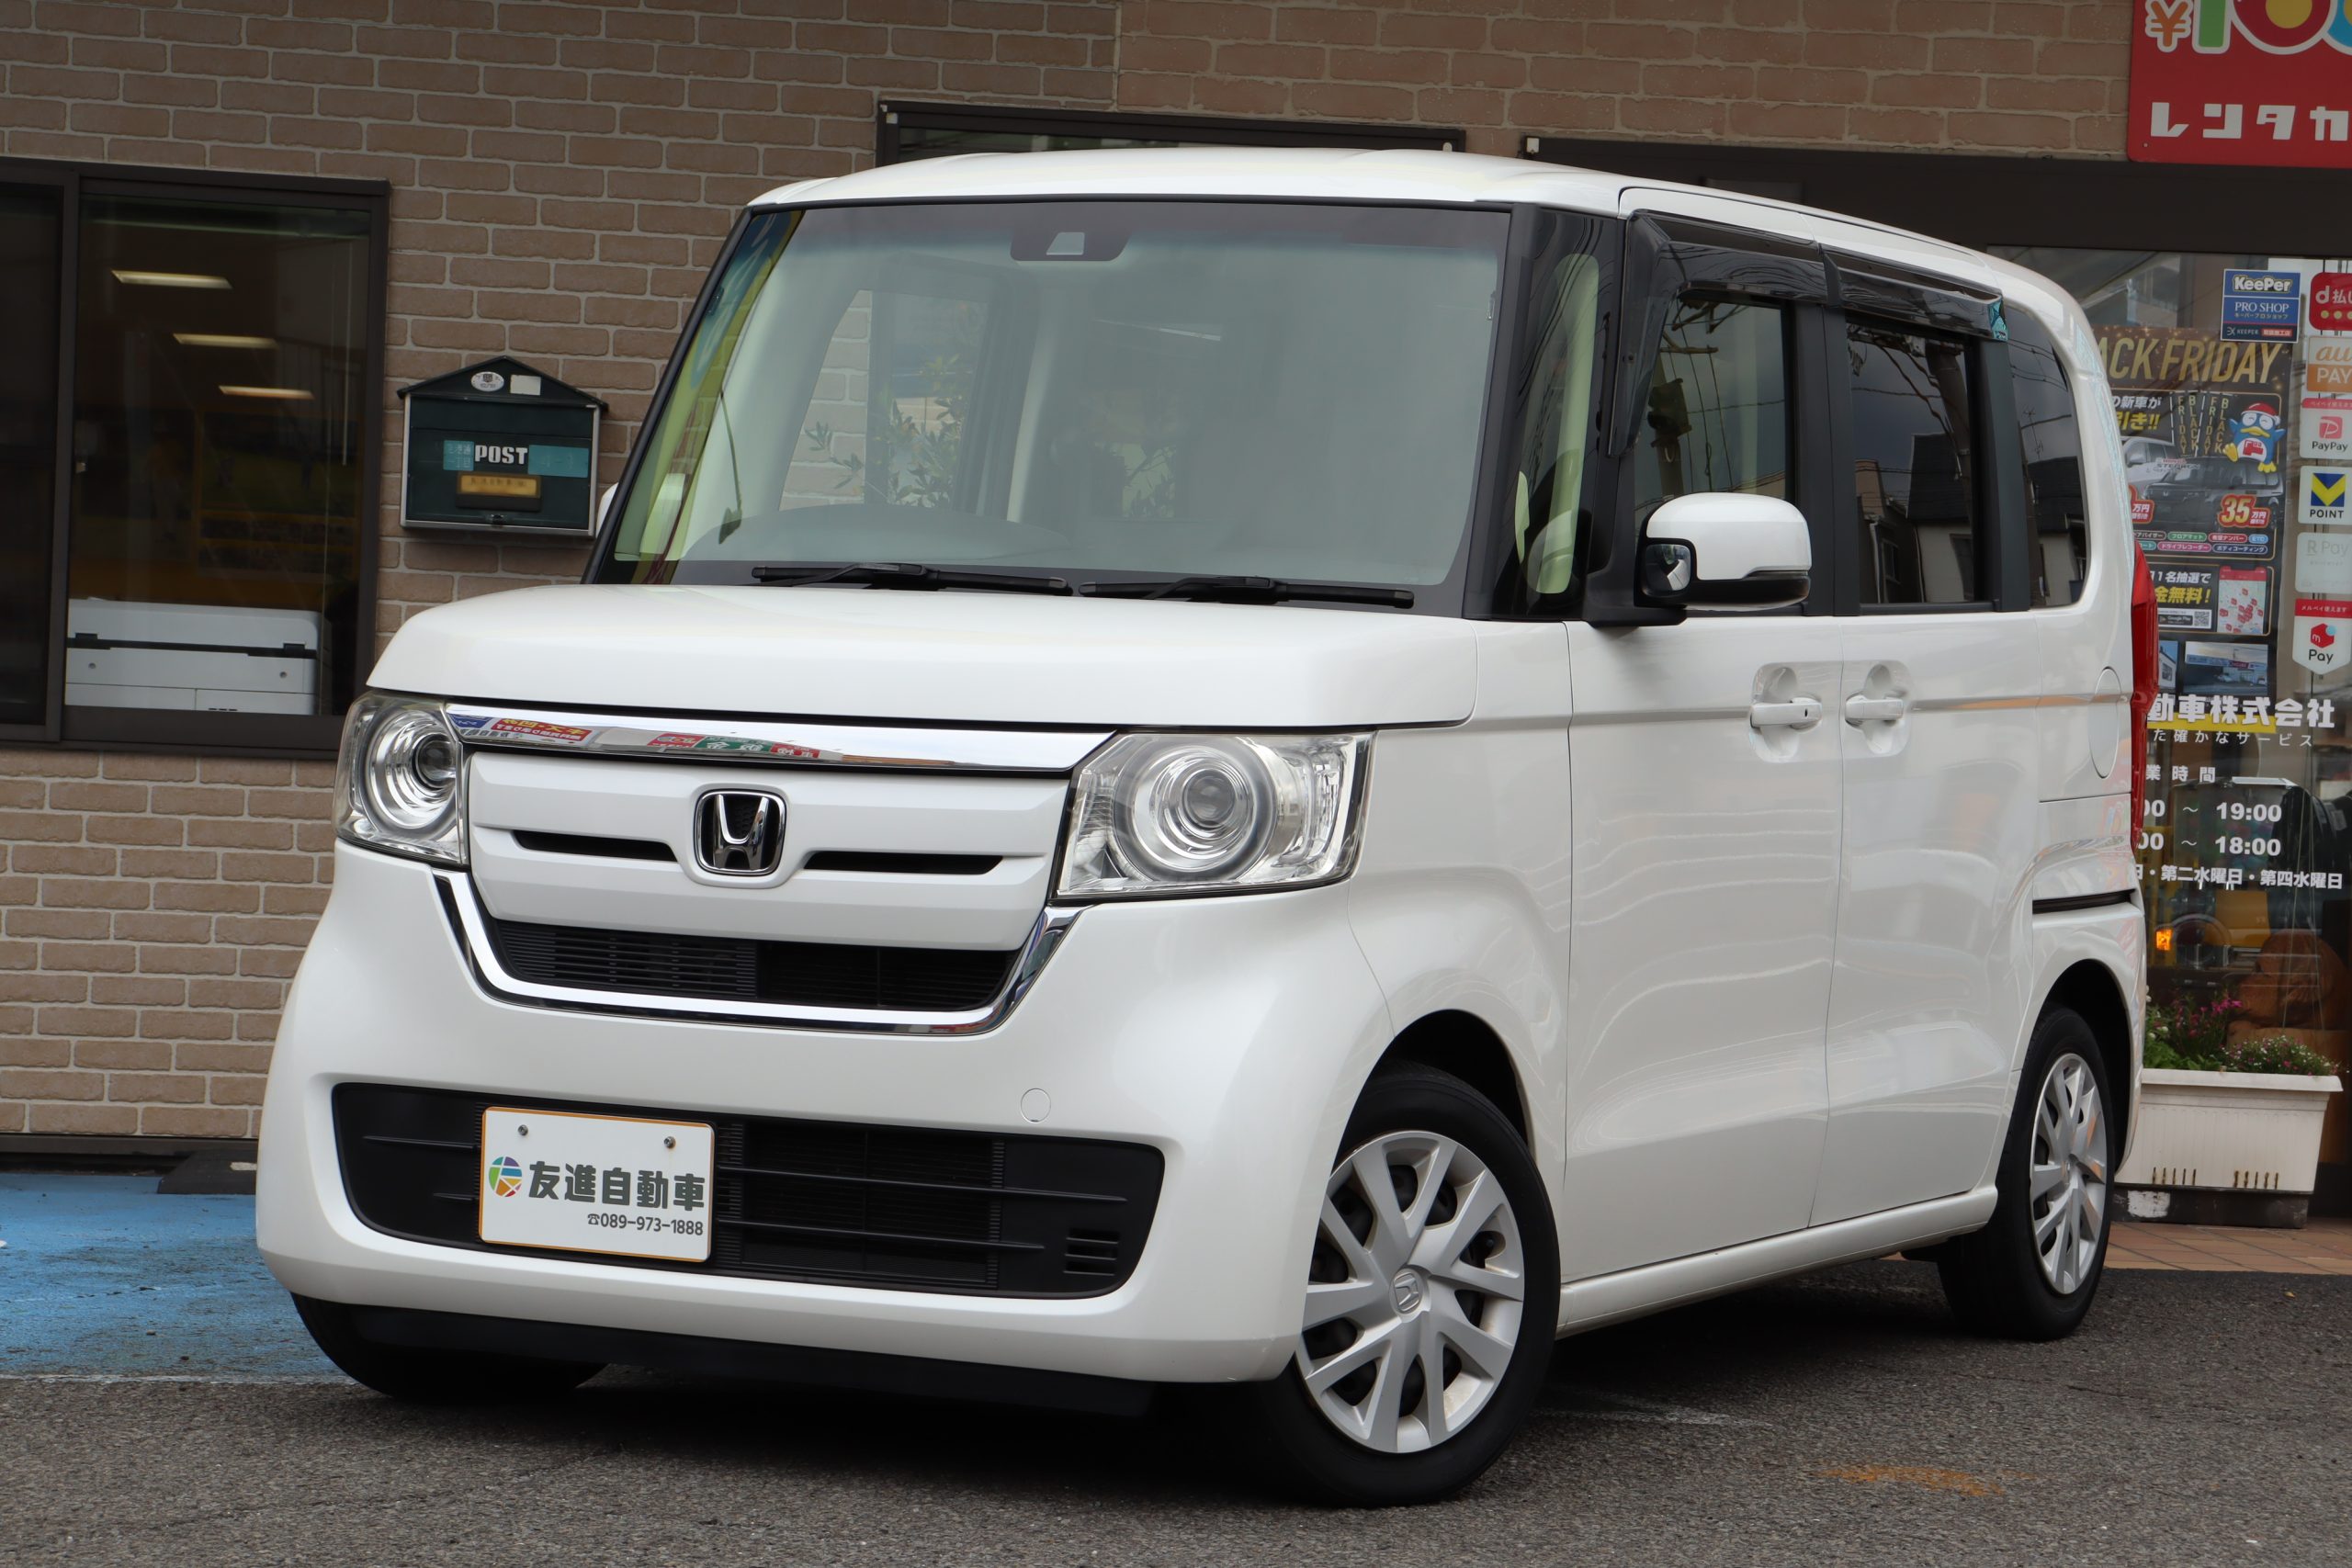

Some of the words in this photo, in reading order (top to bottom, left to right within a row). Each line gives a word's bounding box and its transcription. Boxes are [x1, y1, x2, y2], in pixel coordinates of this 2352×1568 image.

[2151, 102, 2349, 141] レンタカ
[2233, 276, 2291, 292] KeePer
[2234, 301, 2257, 312] PRO
[2259, 302, 2290, 313] SHOP
[2159, 340, 2284, 384] FRIDAY
[2315, 346, 2352, 362] au
[474, 445, 528, 465] POST
[2312, 441, 2348, 452] PayPay
[2132, 503, 2150, 513] 万円
[2221, 497, 2252, 524] 35
[2310, 509, 2345, 519] POINT
[2308, 649, 2334, 665] Pay
[2147, 693, 2335, 728] 動車株式会社
[2154, 728, 2312, 748] た確かなサービス
[2216, 802, 2282, 822] 19:00
[2215, 836, 2281, 856] 18:00
[528, 1161, 706, 1212] 友進自動車
[600, 1213, 704, 1236] 089-973-1888
